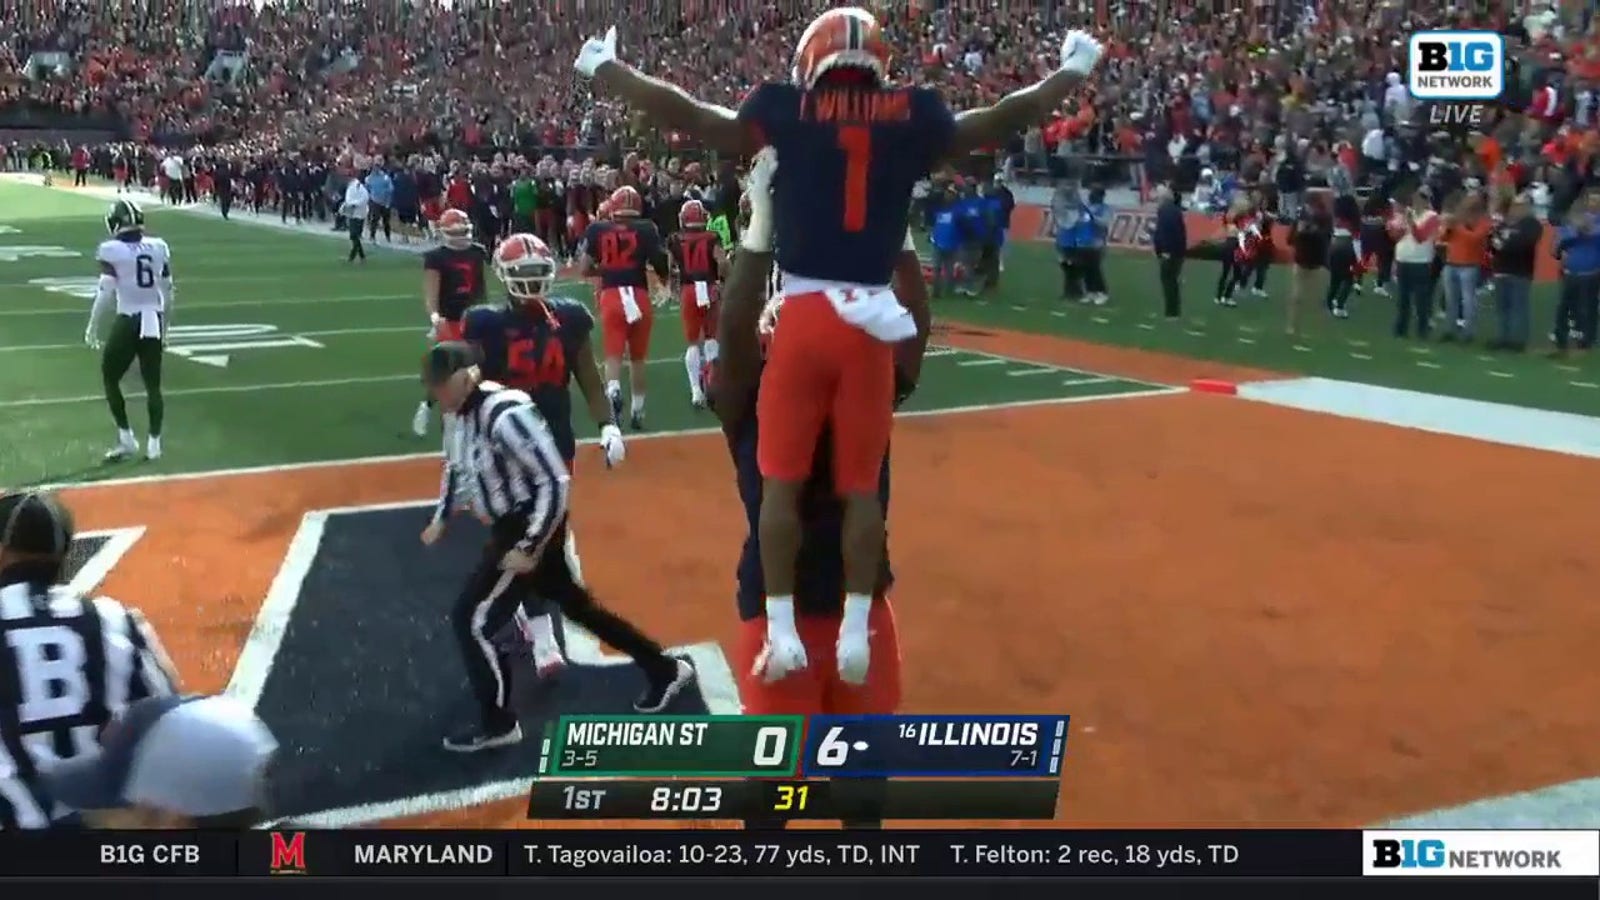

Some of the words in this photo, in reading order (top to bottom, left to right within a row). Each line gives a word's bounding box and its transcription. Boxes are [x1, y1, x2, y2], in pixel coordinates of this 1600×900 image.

[838, 126, 870, 232] 1
[136, 254, 154, 288] 6
[602, 230, 637, 269] 82
[508, 337, 566, 388] 54
[5, 625, 91, 723] B
